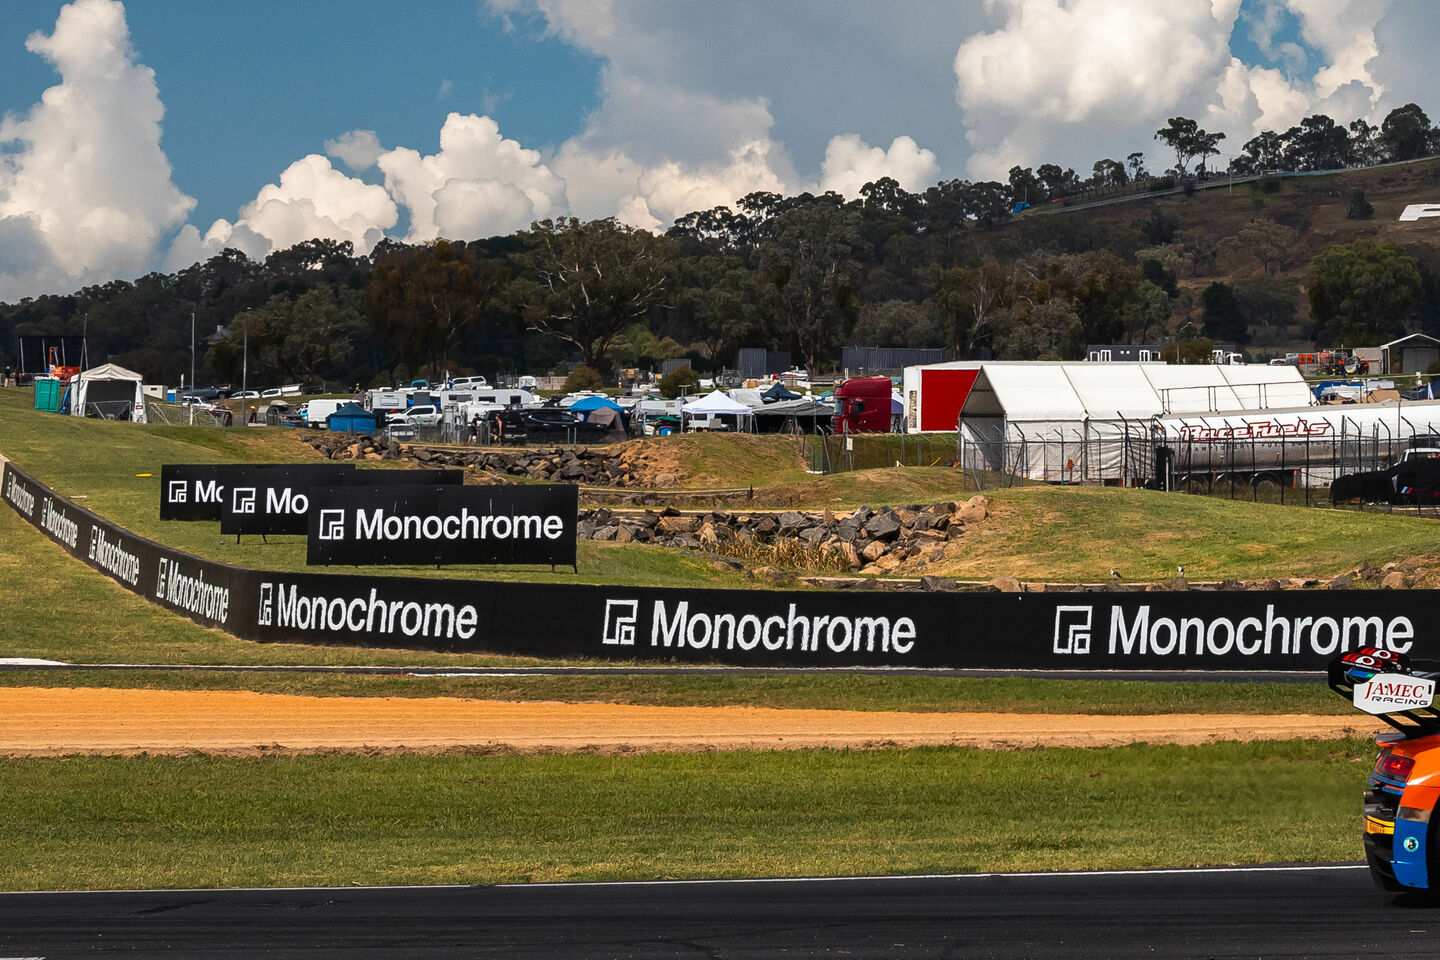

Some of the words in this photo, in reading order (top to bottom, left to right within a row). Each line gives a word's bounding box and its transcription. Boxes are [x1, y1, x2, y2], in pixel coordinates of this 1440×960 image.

[1180, 420, 1330, 442] RaceFuels
[46, 499, 79, 550] Monochrome
[356, 507, 563, 541] Monochrome
[95, 528, 140, 586] Monochrome
[166, 559, 229, 624] Monochrome
[277, 583, 478, 640] Monochrome
[651, 601, 917, 654] Monochrome
[1108, 604, 1415, 656] Monochrome
[1364, 681, 1425, 700] JAMEC
[1371, 696, 1428, 706] RACING
